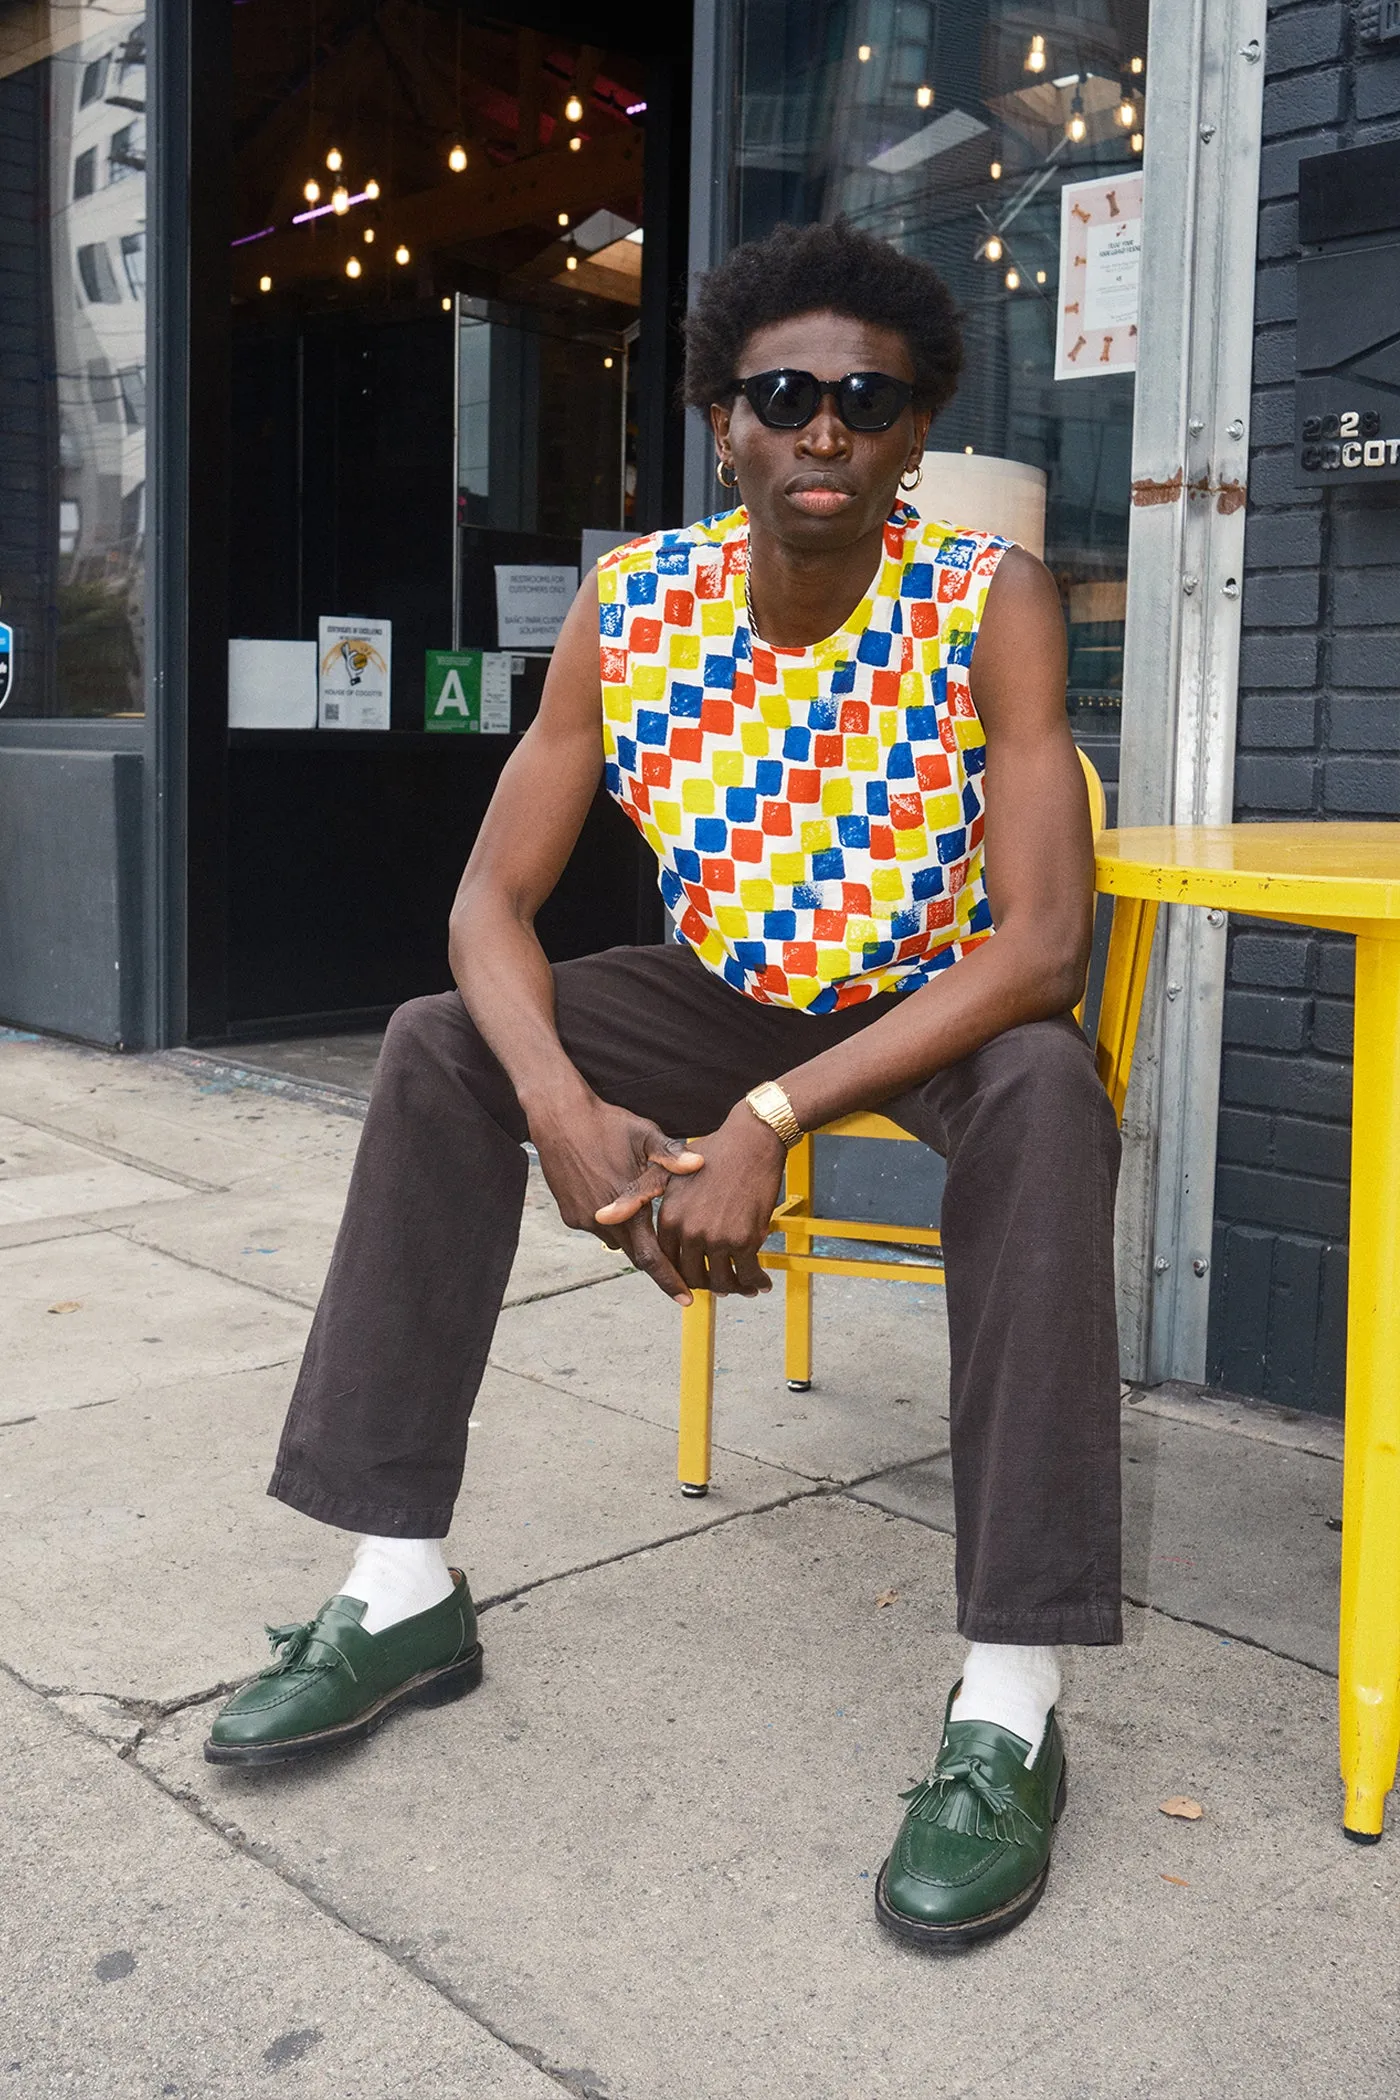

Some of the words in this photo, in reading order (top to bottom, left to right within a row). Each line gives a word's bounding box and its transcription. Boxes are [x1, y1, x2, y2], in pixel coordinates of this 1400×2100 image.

[510, 575, 550, 583] RESTROOMS
[551, 575, 565, 583] FOR
[508, 585, 549, 593] CUSTOMERS
[434, 669, 470, 716] A
